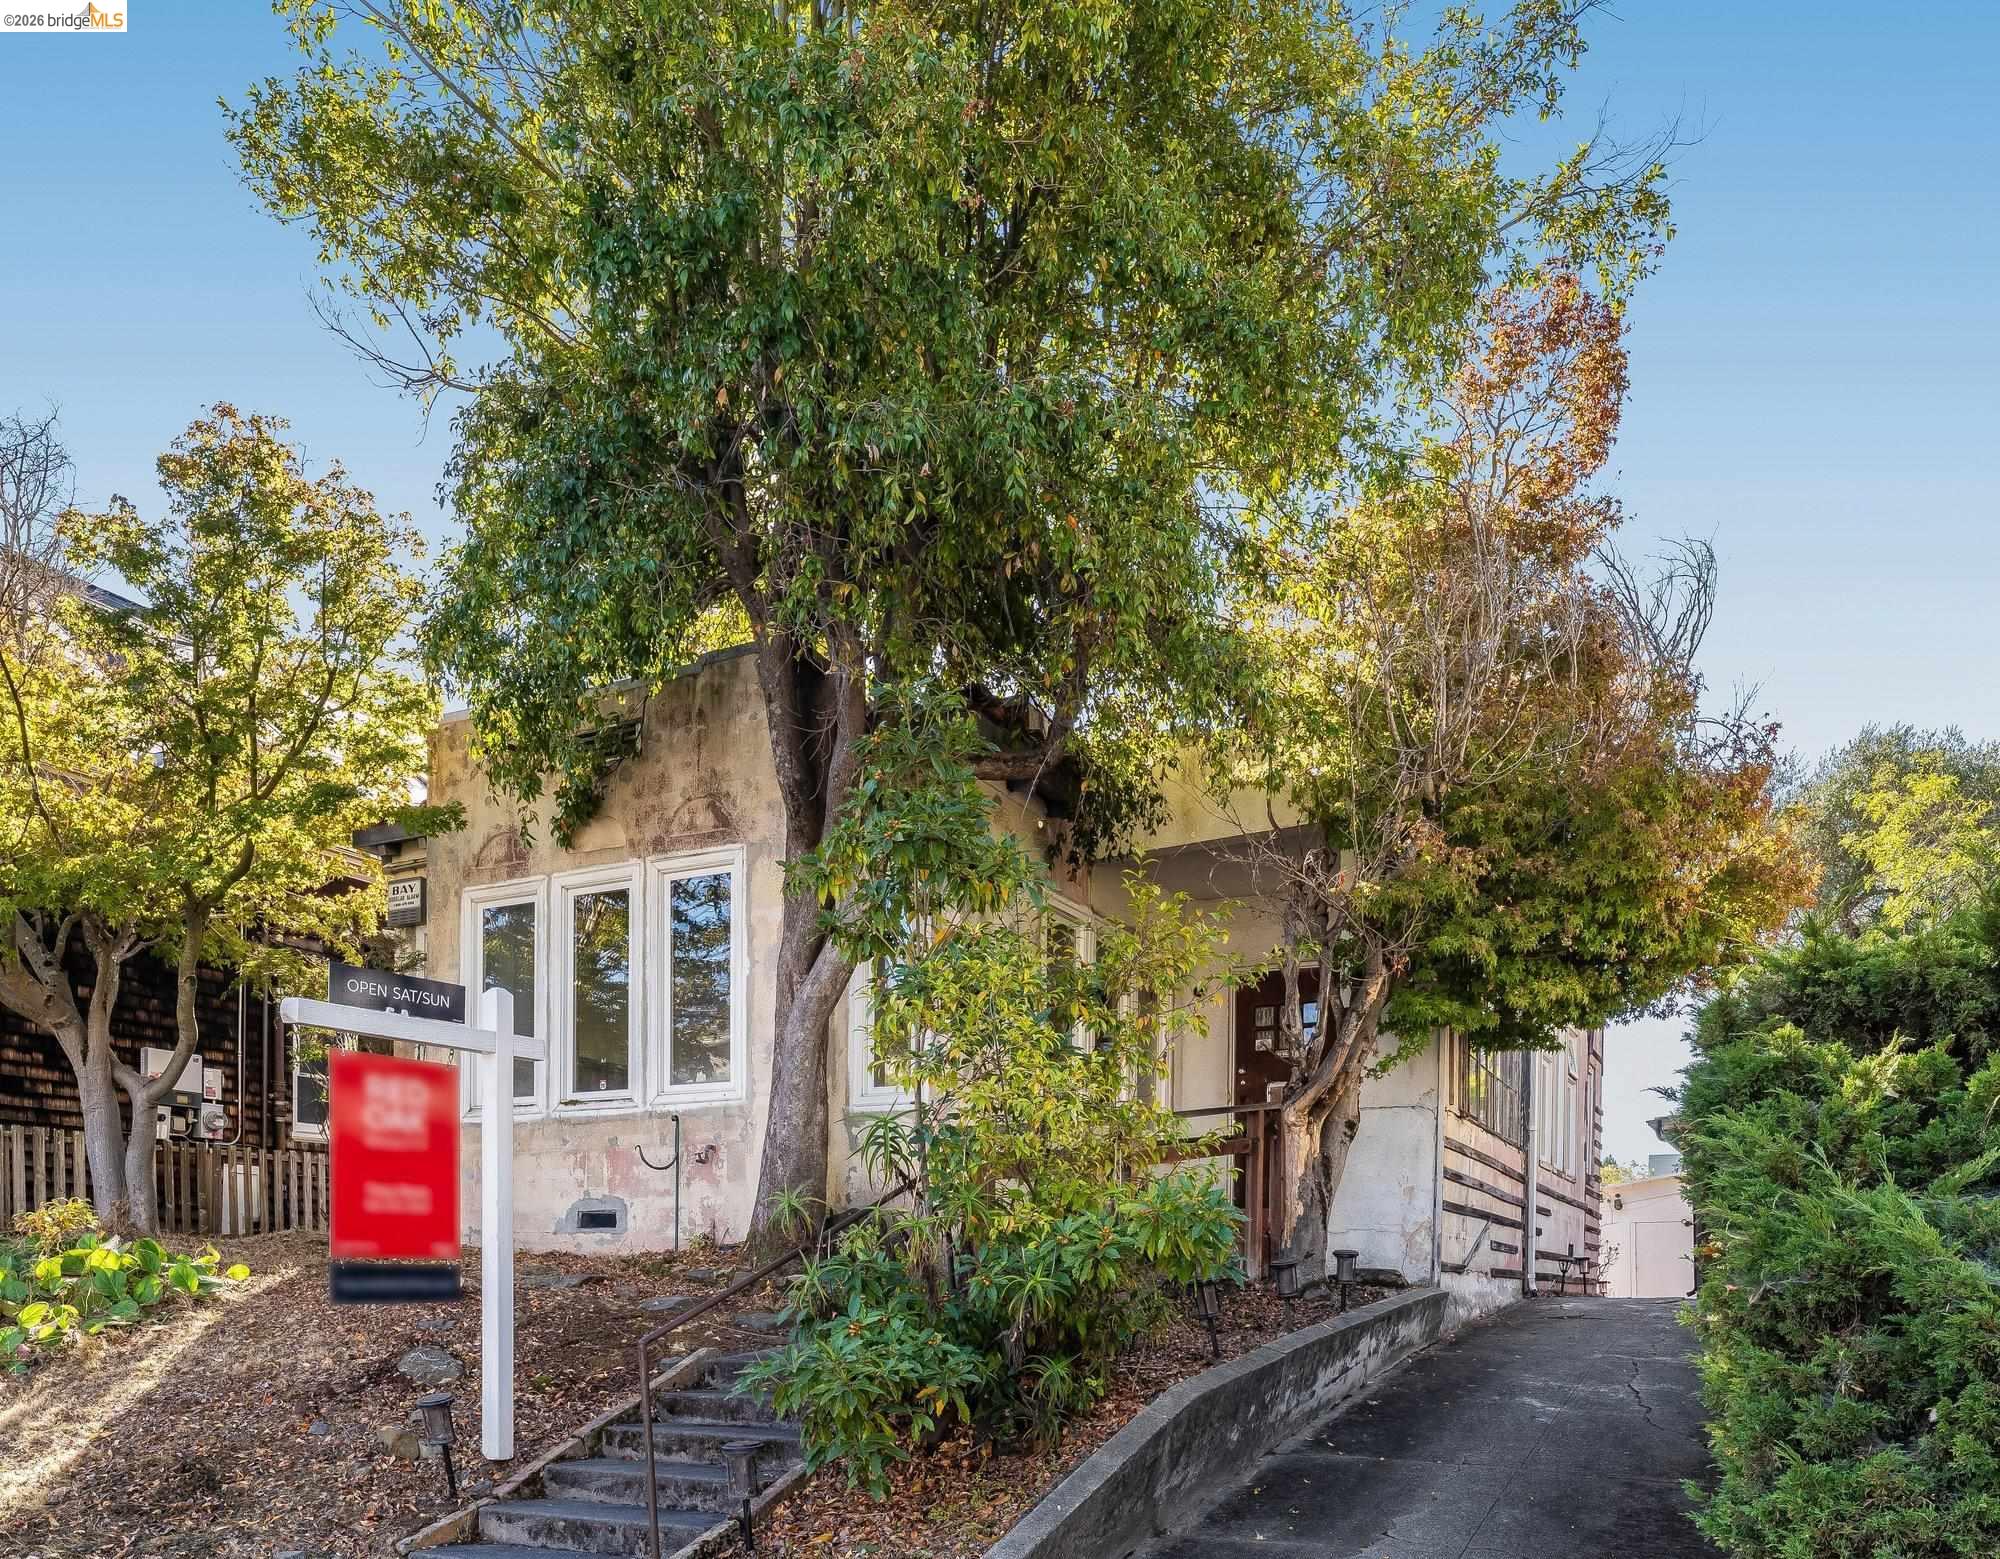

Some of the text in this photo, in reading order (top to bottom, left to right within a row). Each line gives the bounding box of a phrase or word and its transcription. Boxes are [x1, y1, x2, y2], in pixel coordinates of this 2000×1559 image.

[392, 883, 416, 895] BAY
[347, 979, 450, 1009] OPEN SAT/SUN
